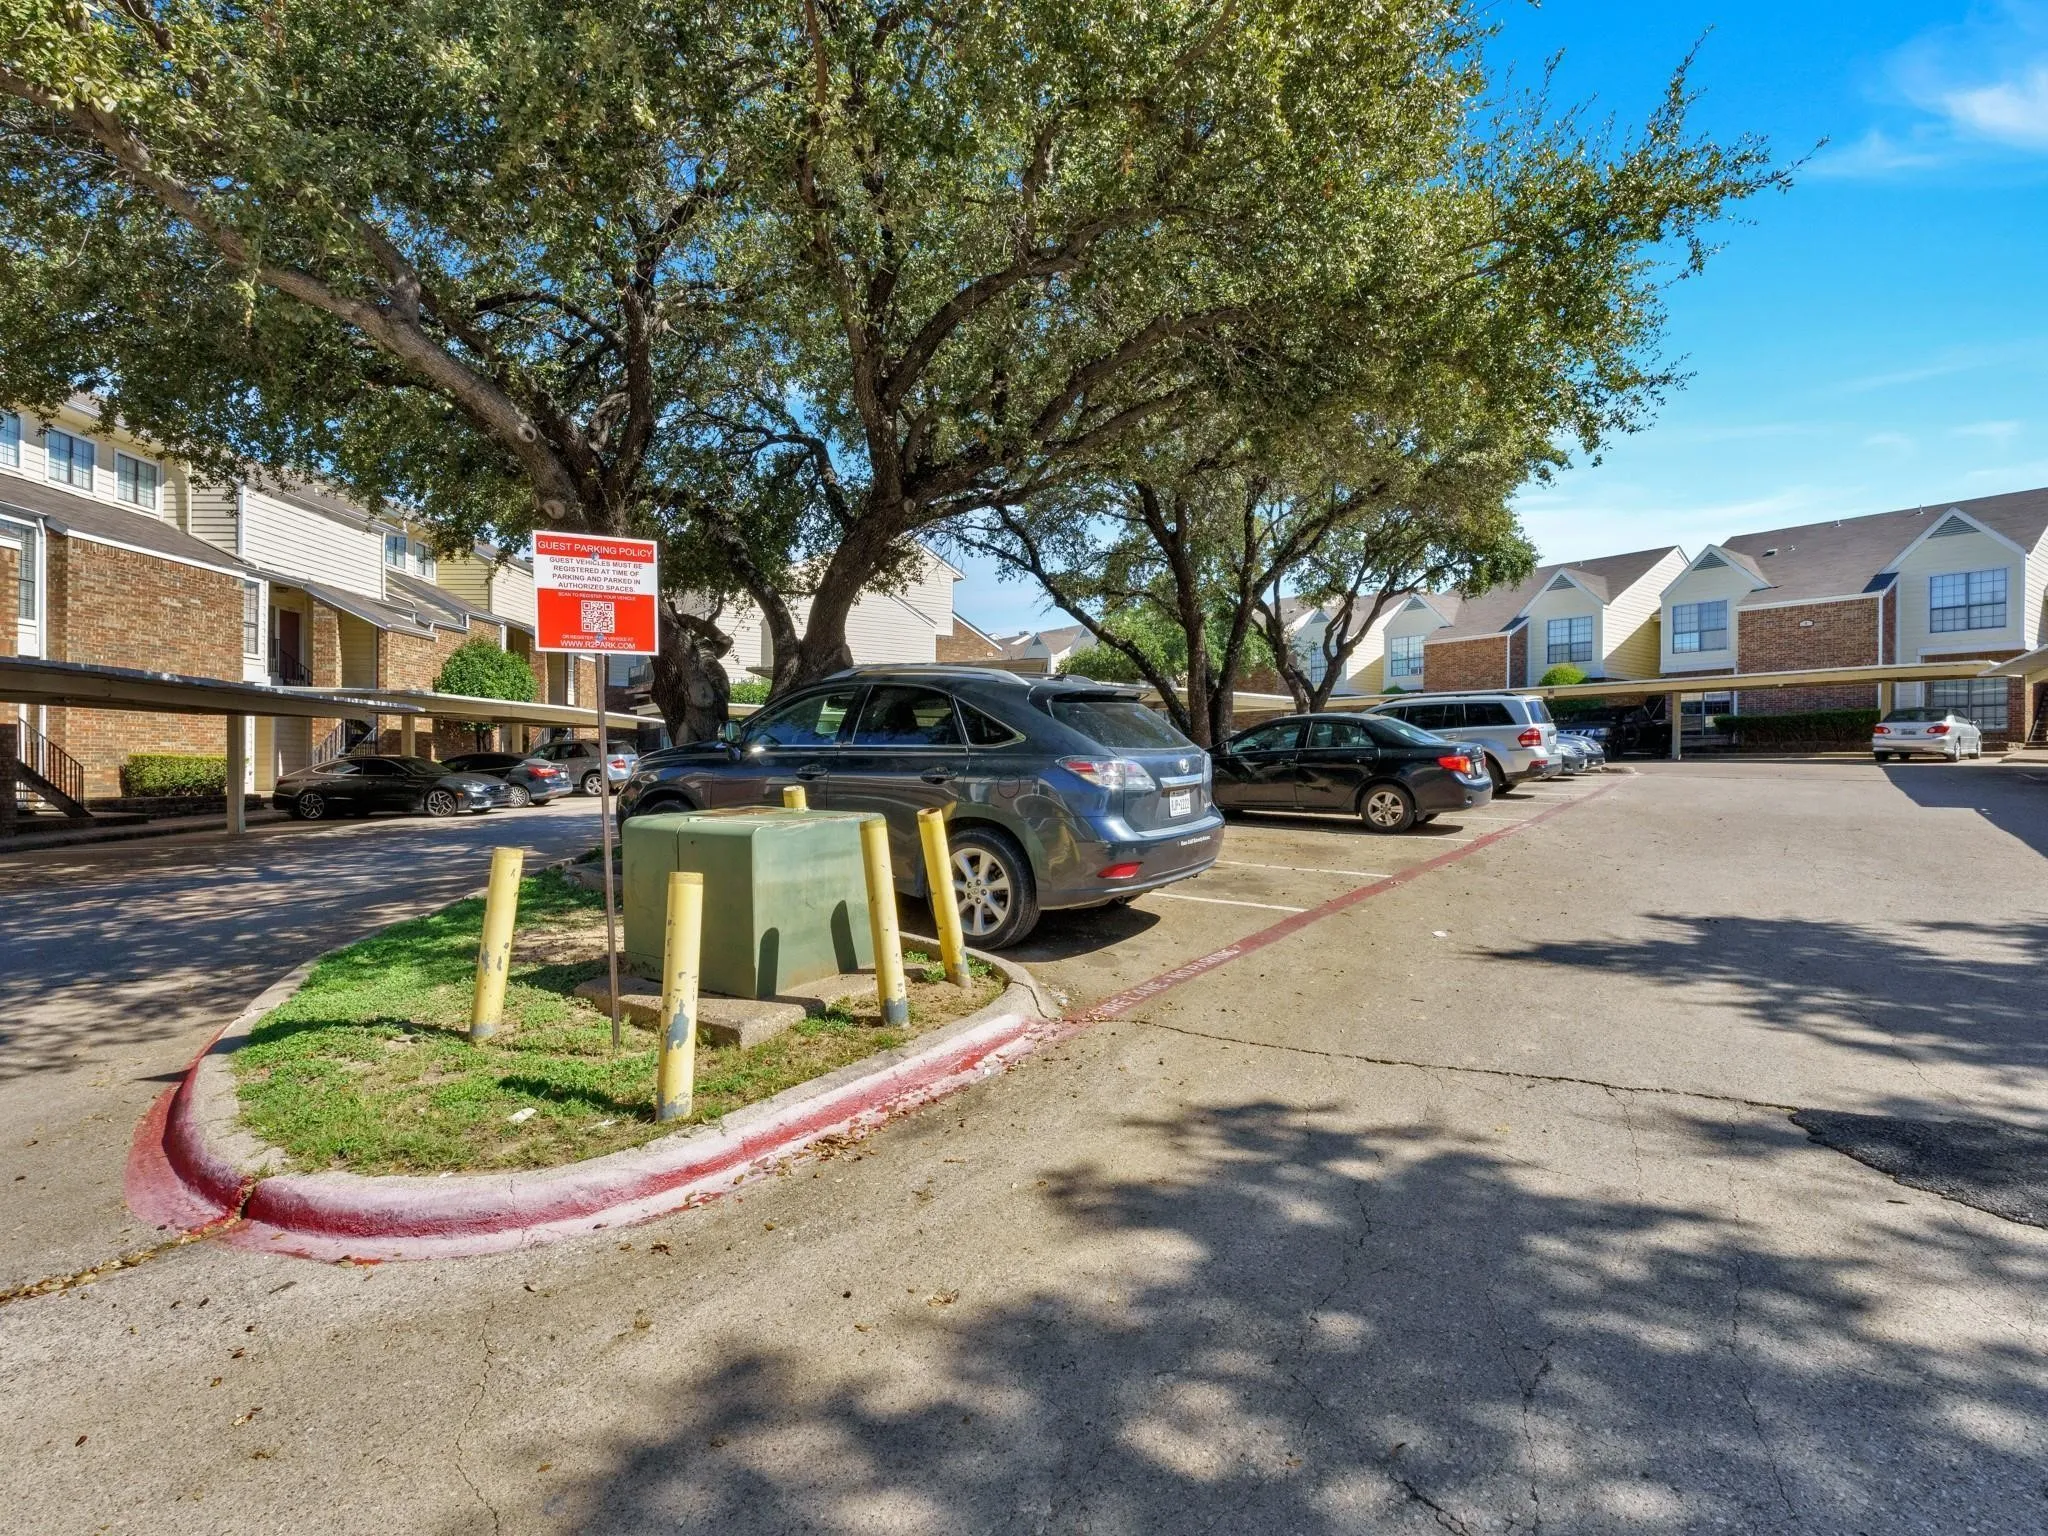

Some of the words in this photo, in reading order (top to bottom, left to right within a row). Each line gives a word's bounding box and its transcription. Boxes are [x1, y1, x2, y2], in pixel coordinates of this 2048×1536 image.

[538, 541, 572, 551] GUEST
[574, 544, 617, 555] PARKING
[619, 547, 653, 557] POLICY
[576, 558, 611, 567] VEHICLES
[553, 565, 599, 574] REGISTERED
[612, 569, 628, 577] TIME
[552, 573, 585, 581] PARKING
[603, 577, 632, 585] PARKED
[558, 582, 604, 591] AUTHORIZED
[606, 585, 636, 593] SPACES.
[560, 640, 636, 650] WWW.R2PARK.COM
